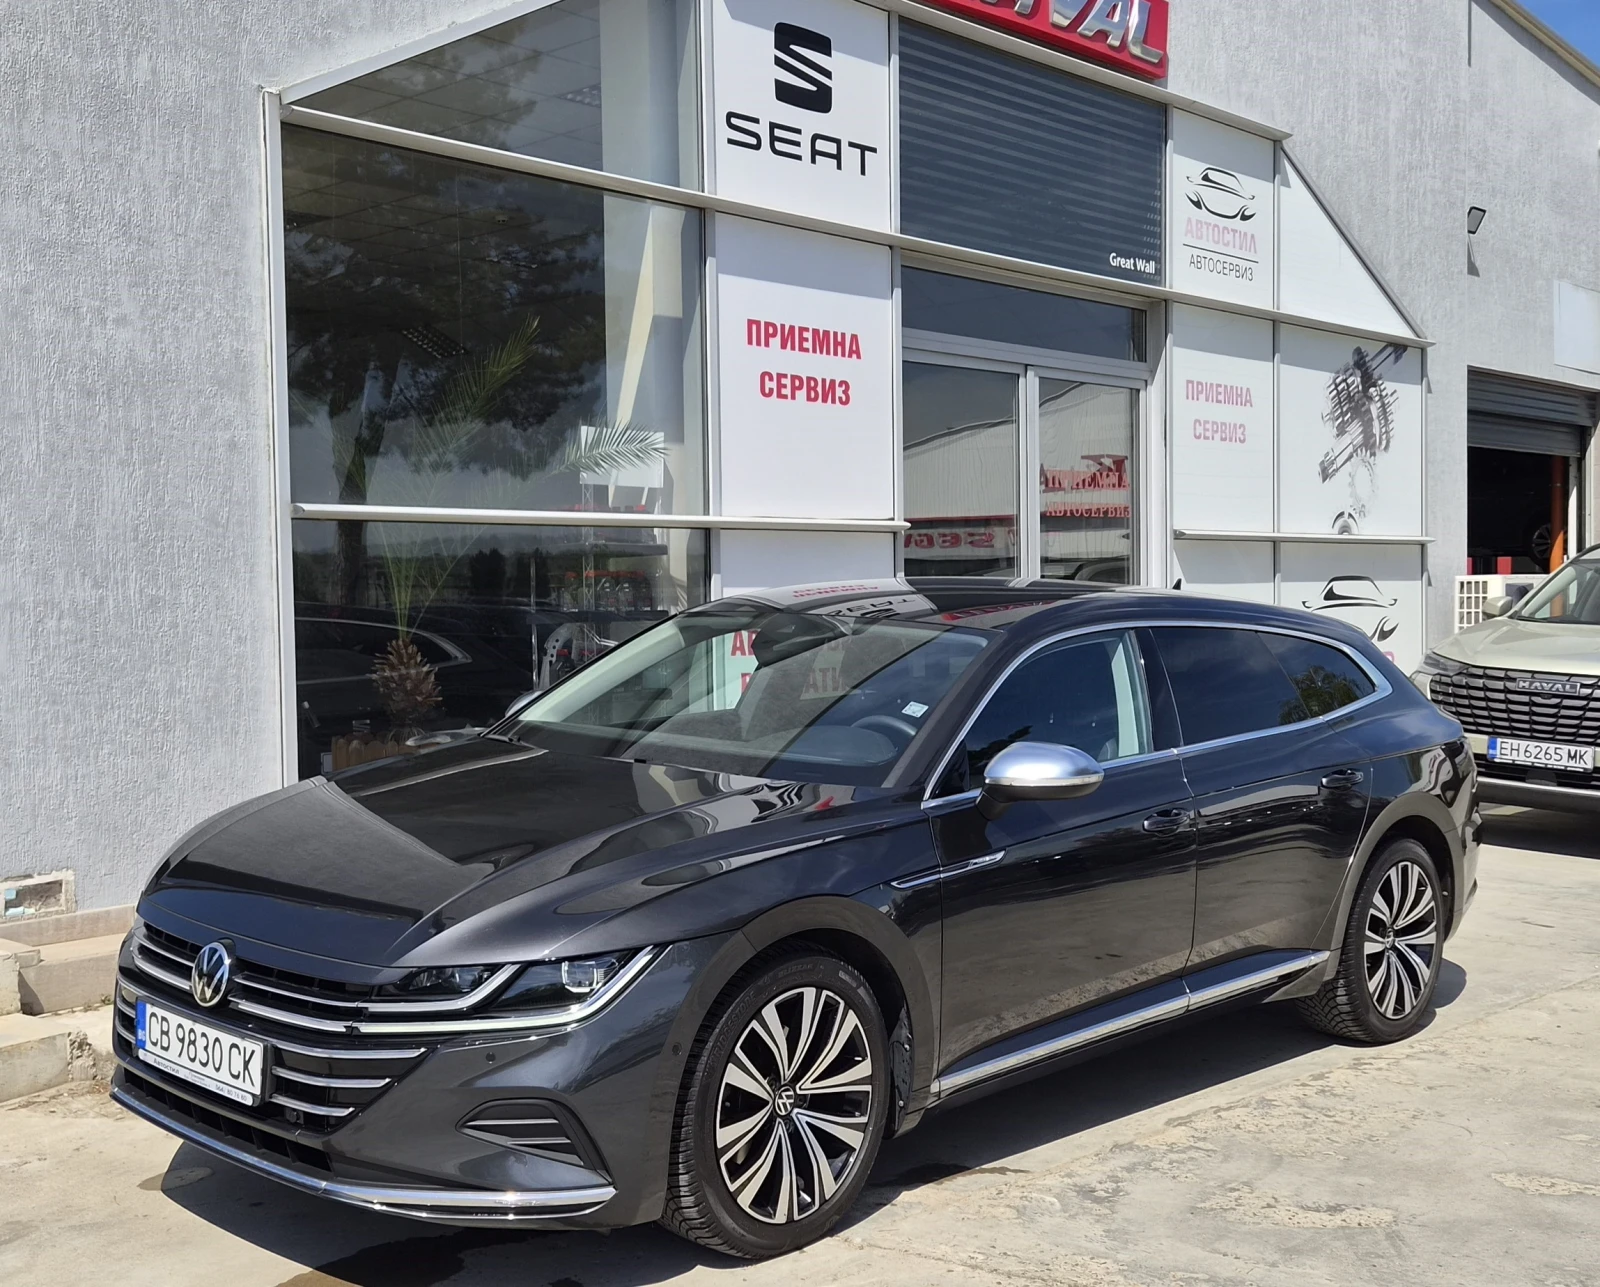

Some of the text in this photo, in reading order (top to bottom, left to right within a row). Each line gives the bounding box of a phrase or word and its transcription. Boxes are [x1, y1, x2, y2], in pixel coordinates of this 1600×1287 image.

[726, 110, 878, 176] SEAT
[1184, 217, 1258, 254] АВТОСТИЛ
[1109, 252, 1155, 274] Great Wall
[1189, 253, 1254, 282] АВТОСЕРВИЗ
[746, 318, 862, 360] ПРИЕМНА
[759, 370, 852, 406] СЕРВИЗ
[1185, 379, 1254, 408] ПРИЕМНА
[1192, 417, 1247, 444] СЕРВИЗ
[1518, 680, 1578, 694] HAVAL
[1500, 741, 1520, 757] EH
[1524, 744, 1563, 762] 6265
[1567, 748, 1588, 765] MK
[149, 1012, 256, 1087] CB 9830 CK
